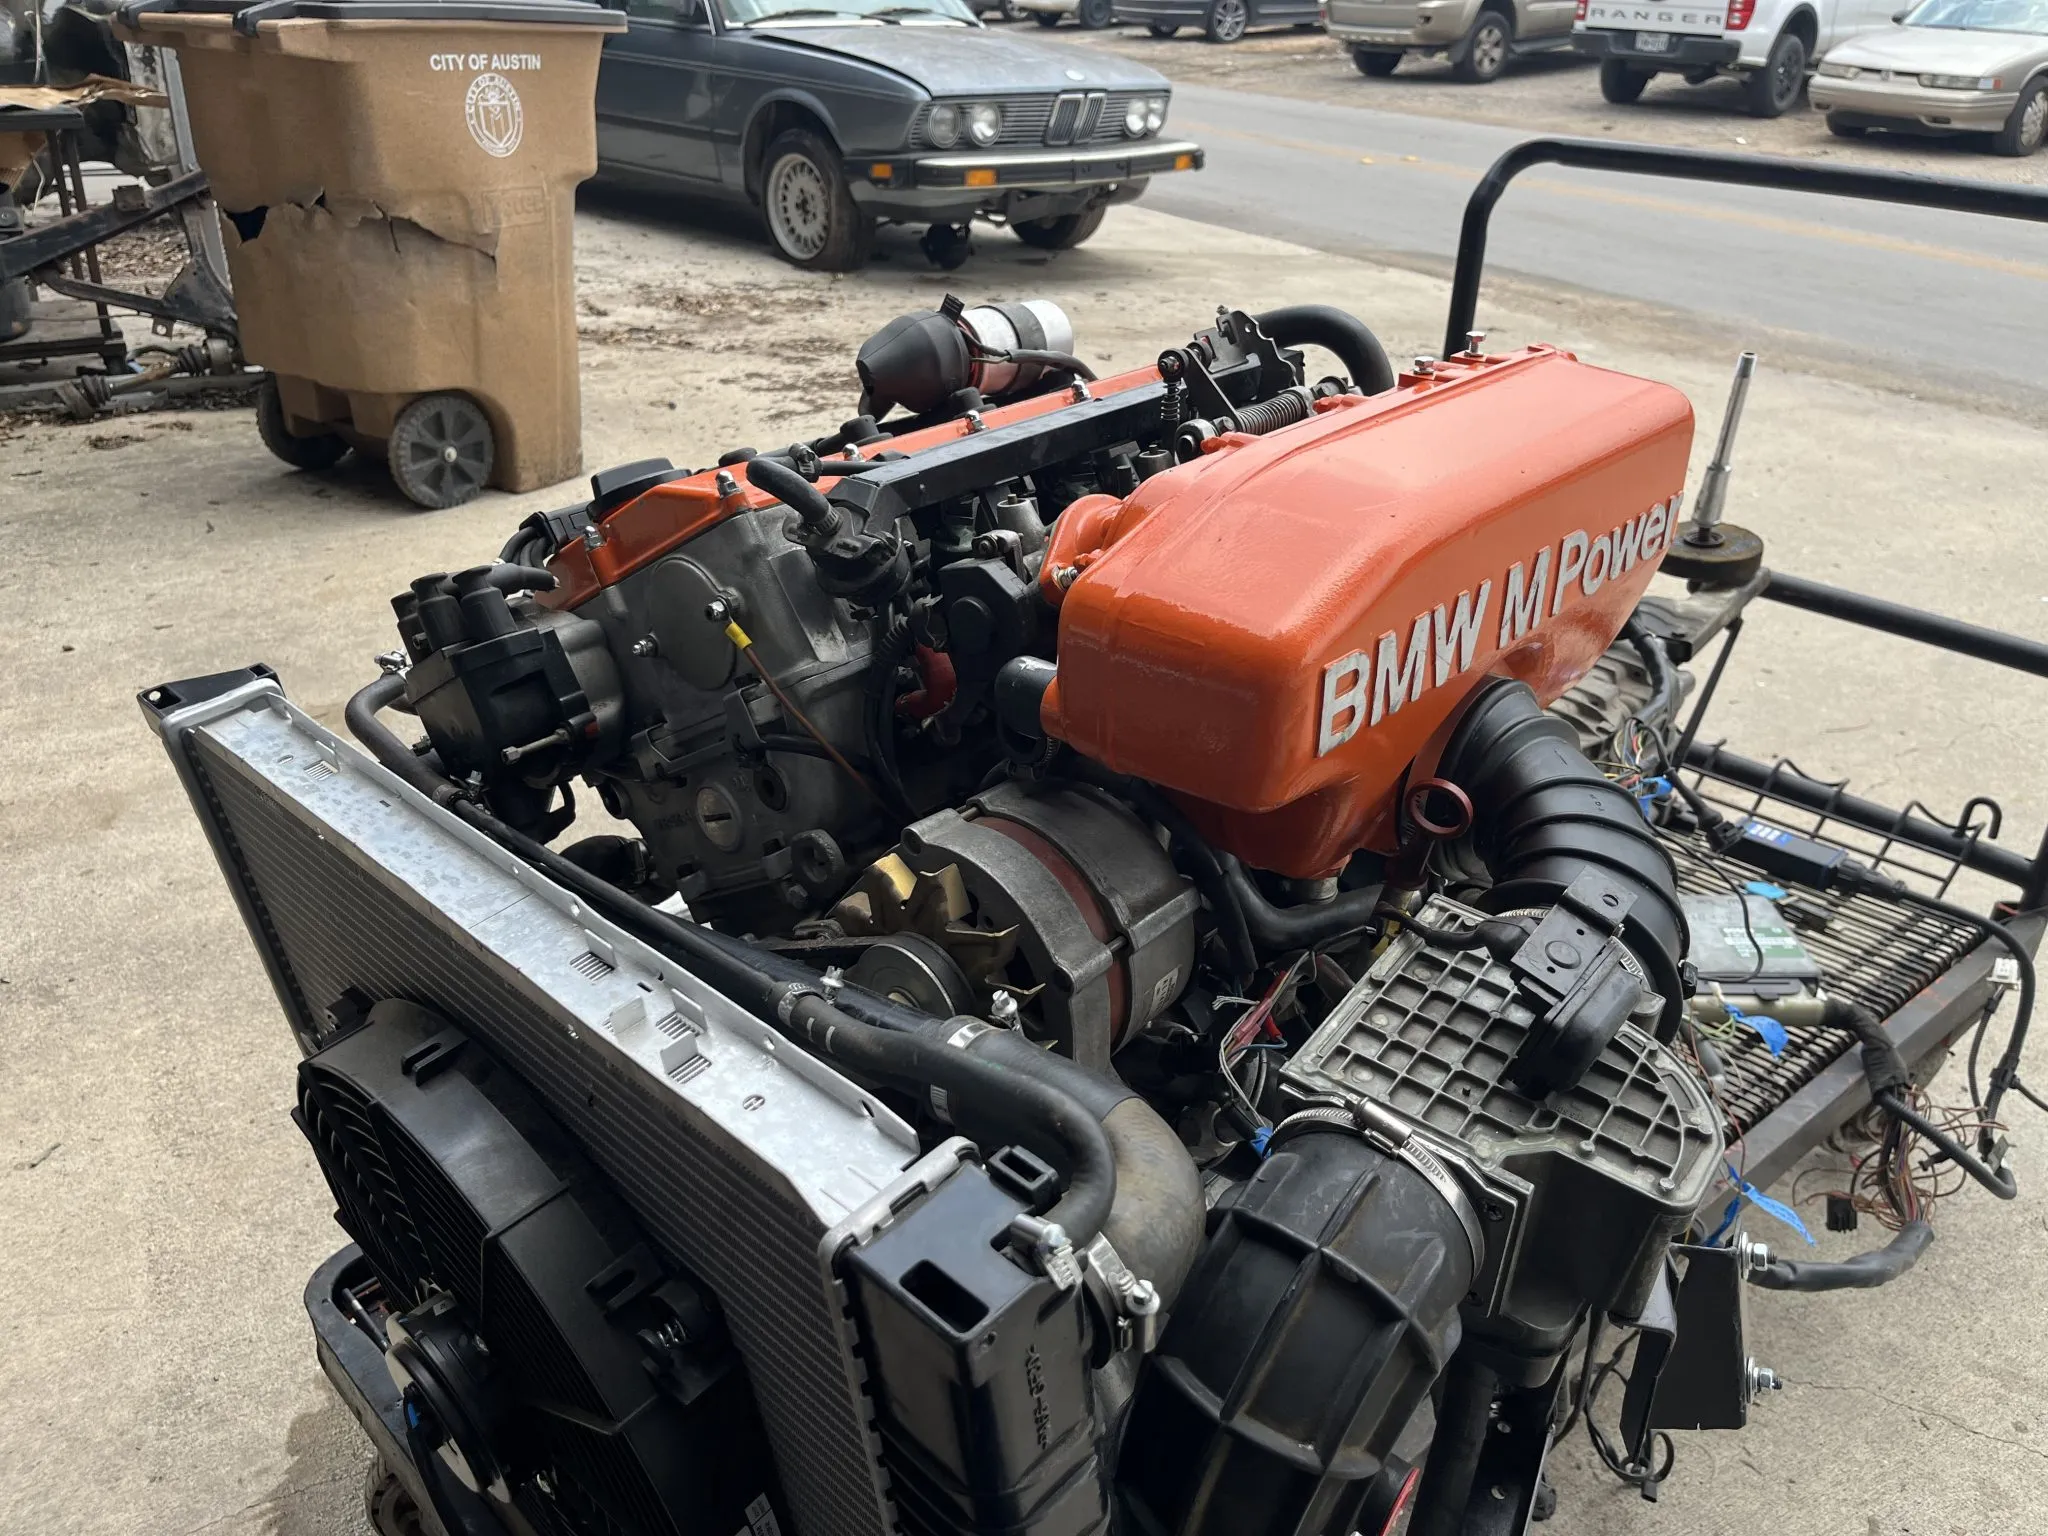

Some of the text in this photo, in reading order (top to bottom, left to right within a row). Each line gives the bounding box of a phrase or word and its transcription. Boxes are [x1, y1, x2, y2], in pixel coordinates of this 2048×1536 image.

[1590, 7, 1722, 25] RANGER
[430, 53, 541, 71] CITY OF AUSTIN
[1315, 577, 1491, 758] BMW
